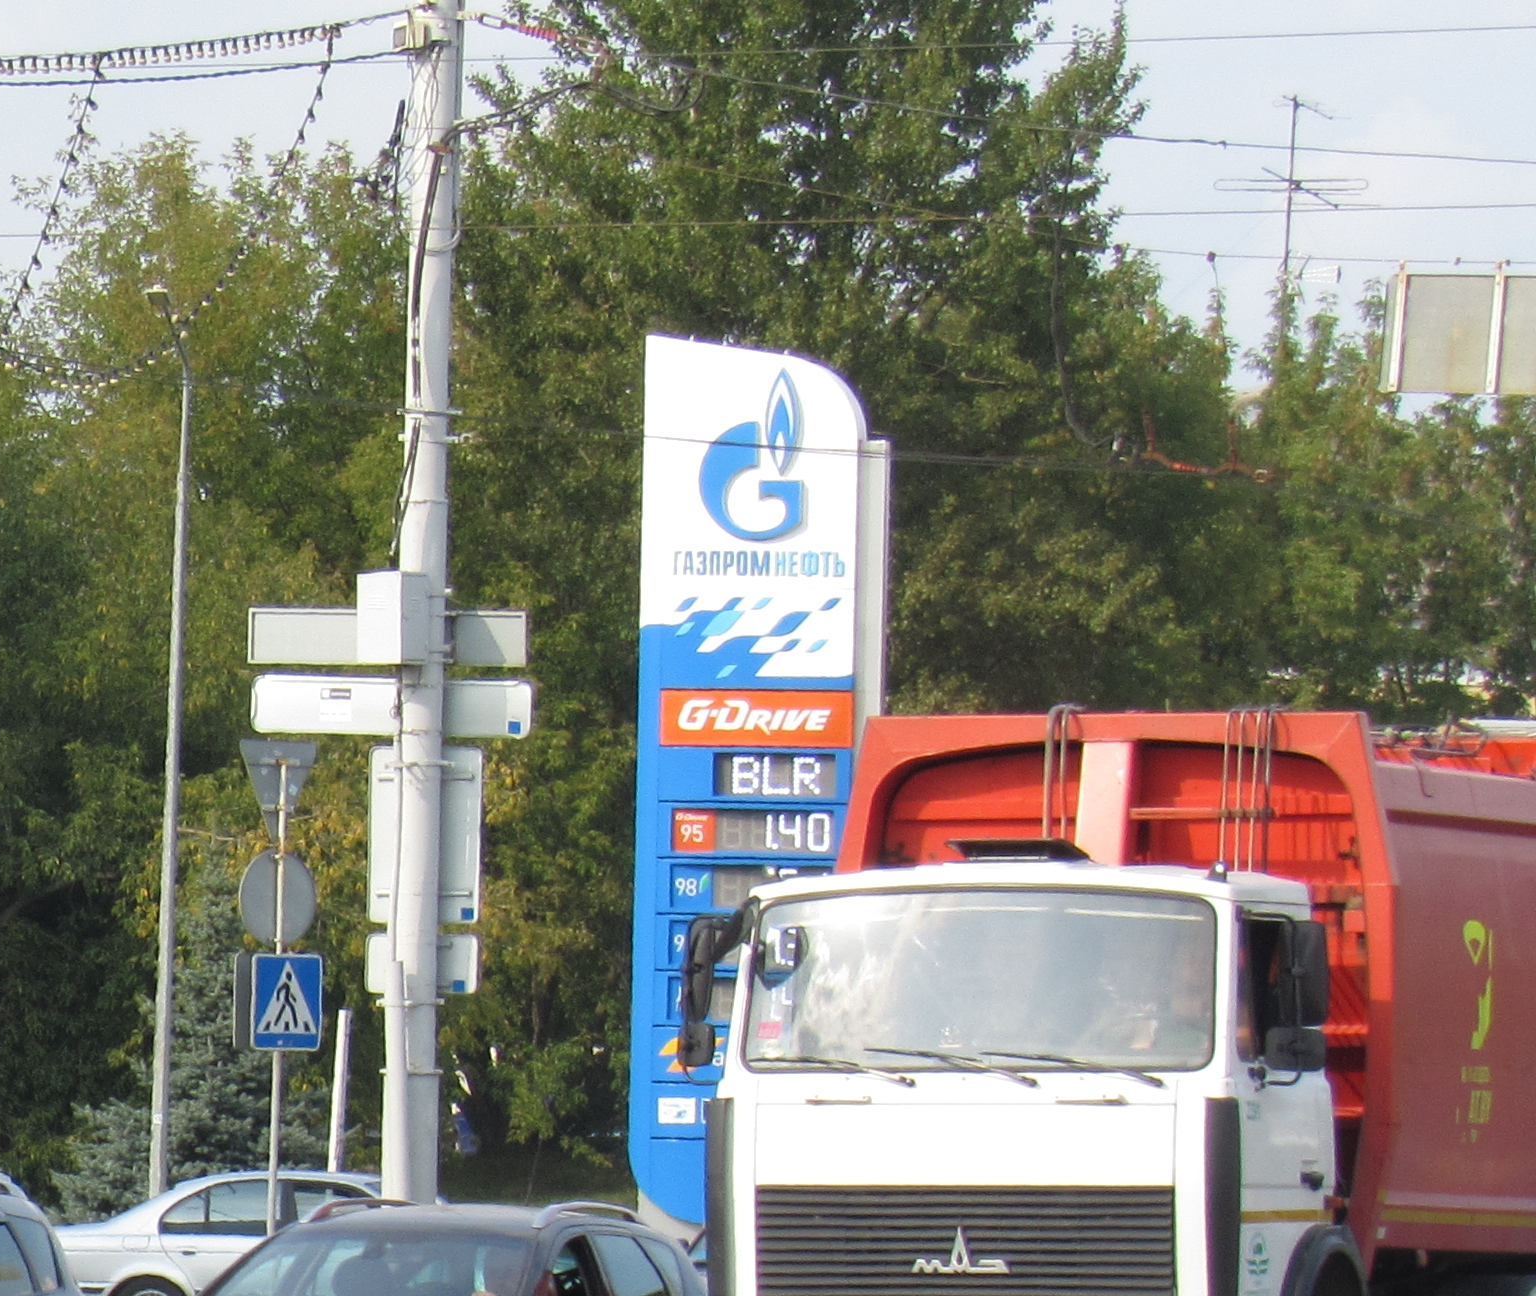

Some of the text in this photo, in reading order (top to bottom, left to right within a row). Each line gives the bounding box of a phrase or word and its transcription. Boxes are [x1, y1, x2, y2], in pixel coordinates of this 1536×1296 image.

[731, 756, 821, 795] BLR
[680, 824, 704, 843] 95
[765, 813, 830, 852] 1.40
[674, 876, 697, 896] 98
